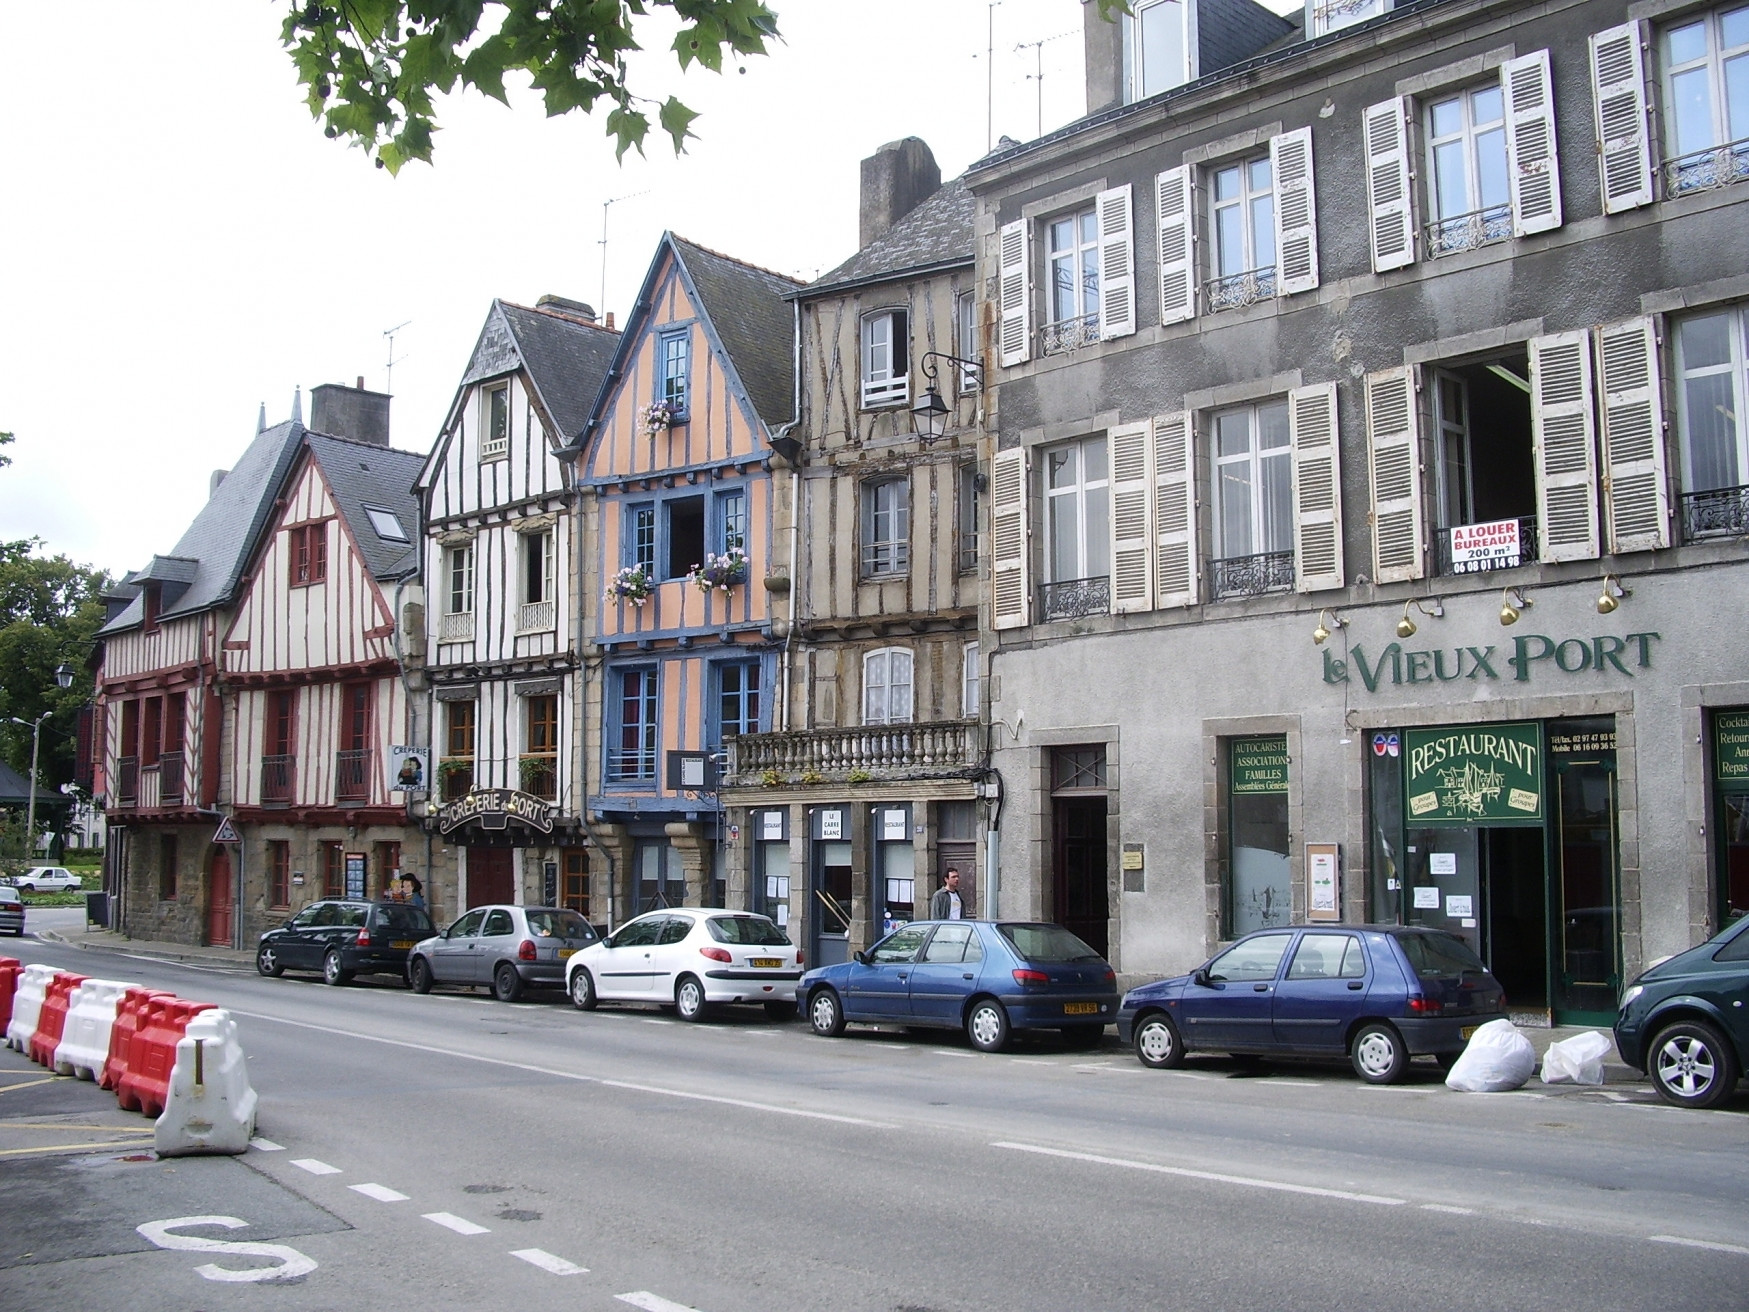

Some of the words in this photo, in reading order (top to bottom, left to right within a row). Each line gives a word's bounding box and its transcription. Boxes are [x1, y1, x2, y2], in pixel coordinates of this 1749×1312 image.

[1454, 530, 1464, 540] A
[1468, 523, 1516, 539] LOUER
[1454, 534, 1517, 550] BUREAUX
[1468, 548, 1490, 558] 200
[1454, 562, 1465, 573] 06
[1467, 561, 1479, 572] 08
[1480, 559, 1491, 570] 01
[1494, 558, 1506, 569] 14
[1507, 556, 1519, 567] 98
[1322, 648, 1350, 684] le
[1507, 631, 1661, 682] PORT
[1582, 734, 1589, 742] 97
[1583, 743, 1590, 751] 16
[1411, 734, 1537, 780] RESTAURANT
[1245, 769, 1282, 780] FAMILLES
[1722, 761, 1748, 775] Repas
[136, 1215, 319, 1282] S
